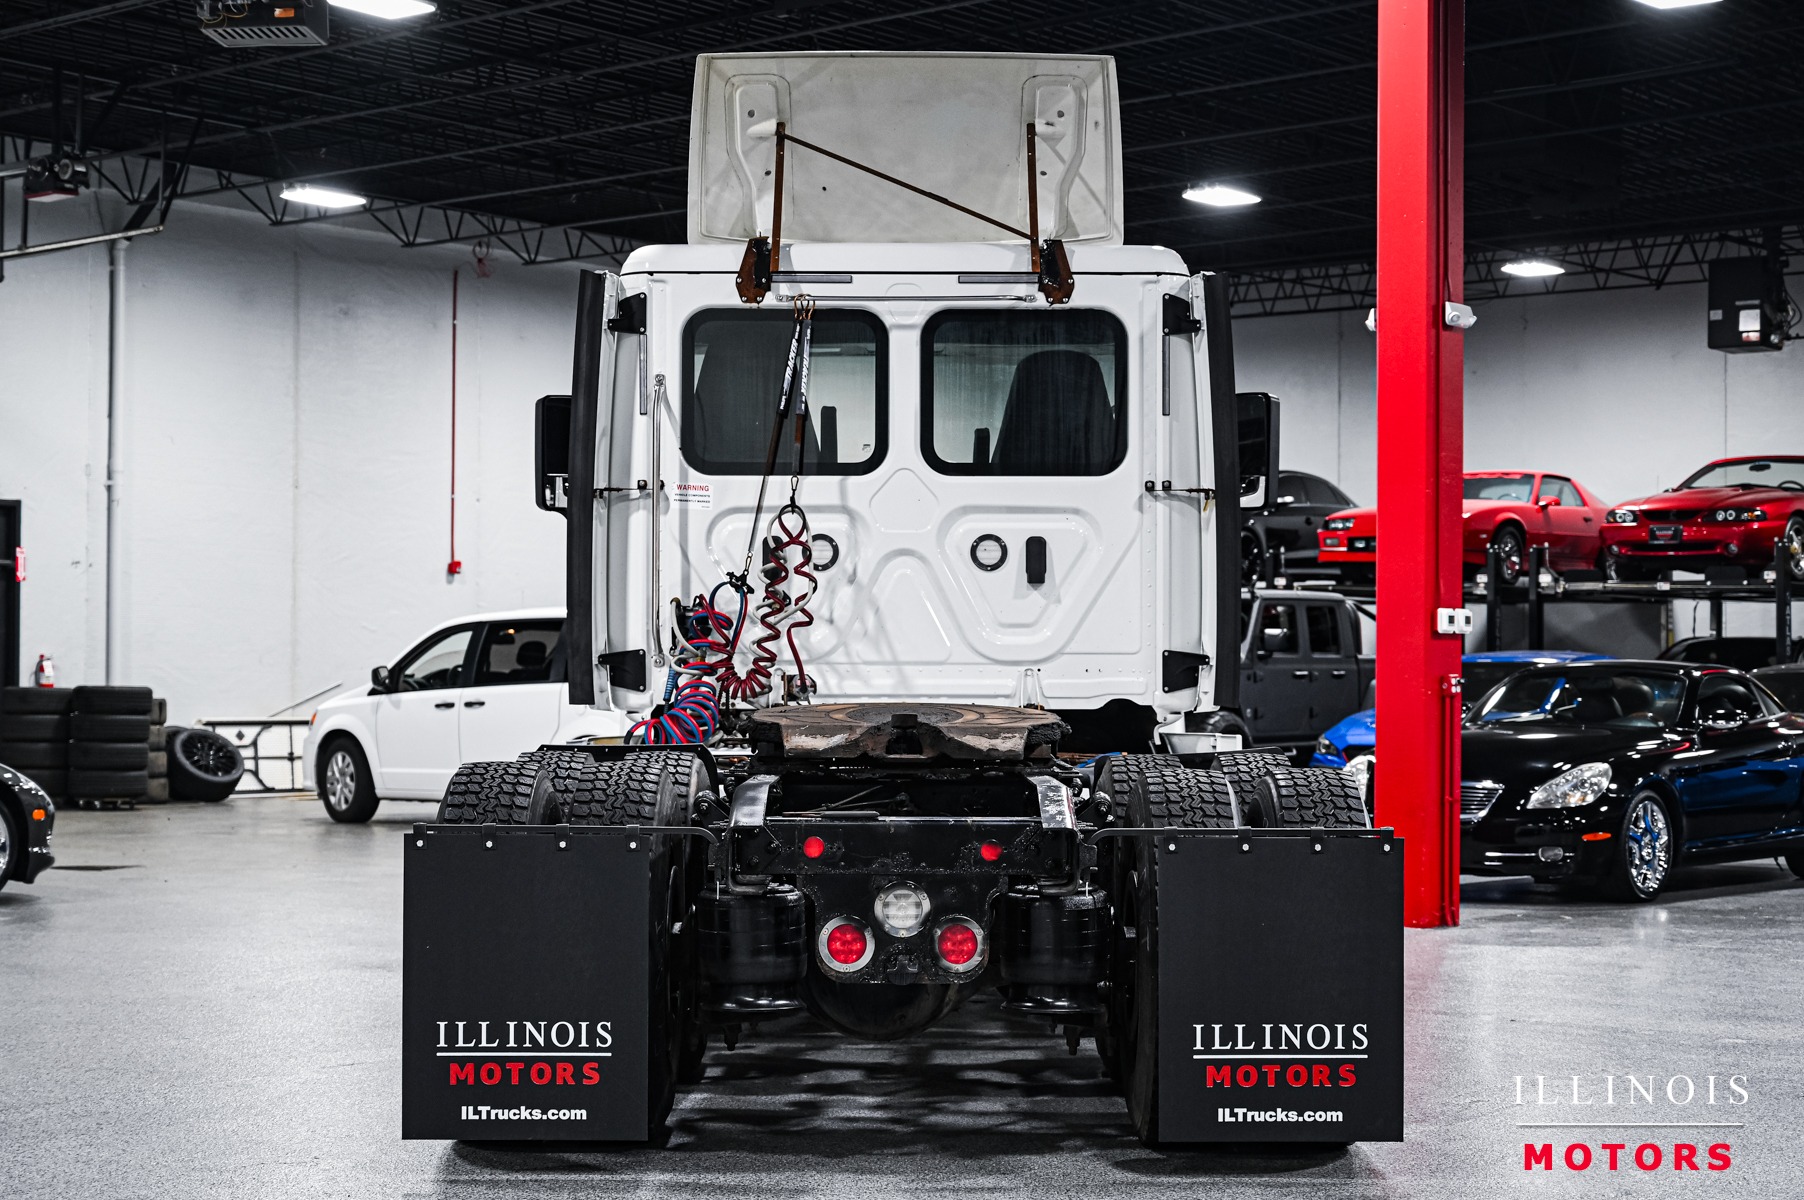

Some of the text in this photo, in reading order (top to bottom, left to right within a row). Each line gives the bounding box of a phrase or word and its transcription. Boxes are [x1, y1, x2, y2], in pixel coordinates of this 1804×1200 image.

[785, 338, 798, 380] TRACKER
[436, 1021, 613, 1048] ILLINOIS
[1192, 1023, 1369, 1050] ILLINOIS
[449, 1062, 600, 1086] MOTORS
[1205, 1063, 1357, 1088] MOTORS
[461, 1105, 587, 1121] ILTrucks.com
[1217, 1107, 1344, 1123] ILTrucks.com
